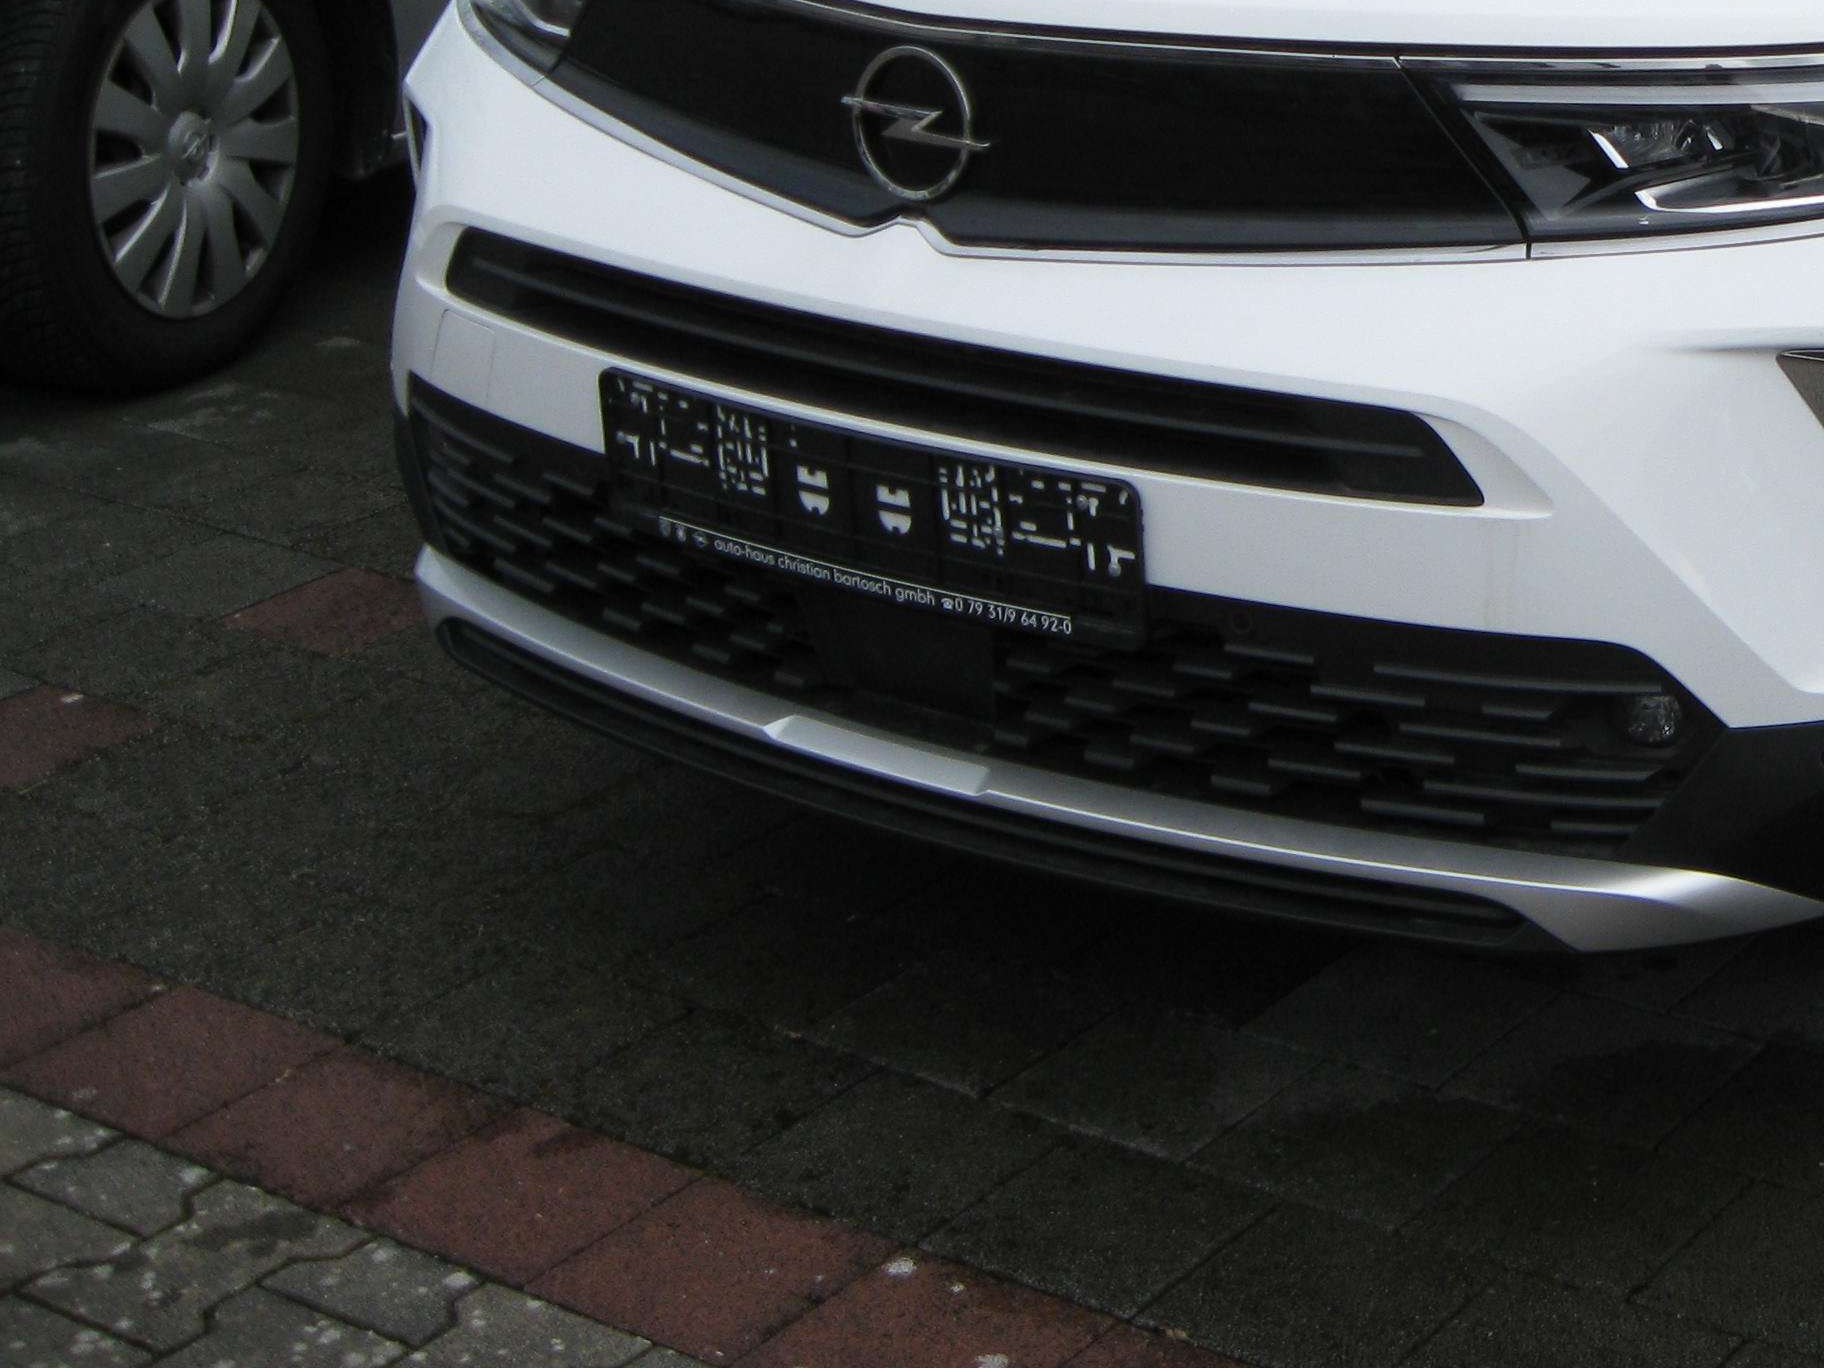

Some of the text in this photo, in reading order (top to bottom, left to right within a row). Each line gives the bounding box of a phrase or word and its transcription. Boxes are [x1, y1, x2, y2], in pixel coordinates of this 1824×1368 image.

[713, 538, 776, 565] auto-haus
[777, 554, 831, 580] christian
[832, 568, 892, 595] bartosch
[894, 586, 935, 606] gmbh
[1020, 611, 1038, 628] 64
[1040, 615, 1072, 635] 92-0
